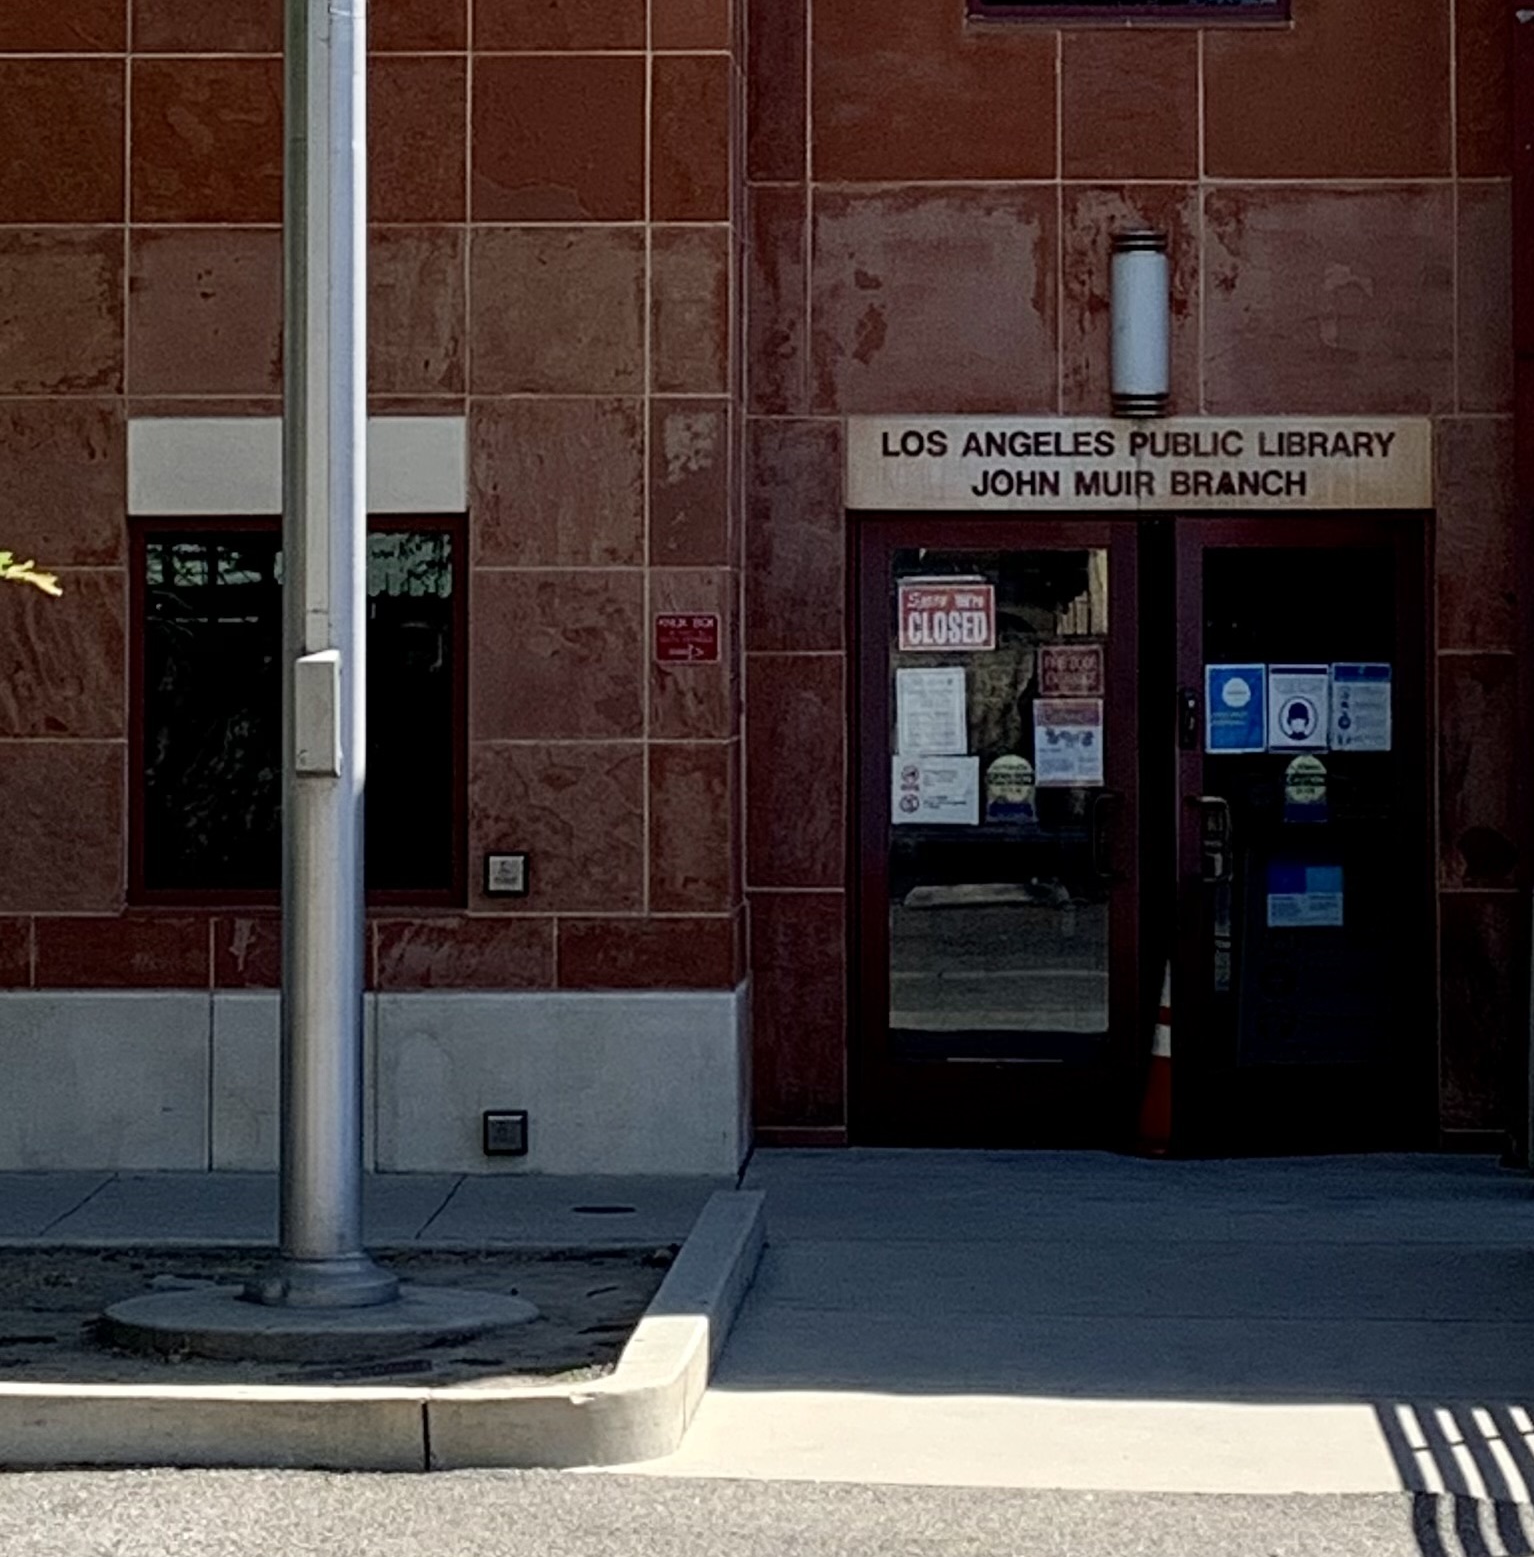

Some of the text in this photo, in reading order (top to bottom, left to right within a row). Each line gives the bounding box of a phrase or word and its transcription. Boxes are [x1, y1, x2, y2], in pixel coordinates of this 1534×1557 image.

[881, 430, 1396, 458] LOS ANGELES PUBLIC LIBRARY
[971, 470, 1308, 497] JOHN MUIR BRANCH
[908, 611, 987, 644] CLOSED
